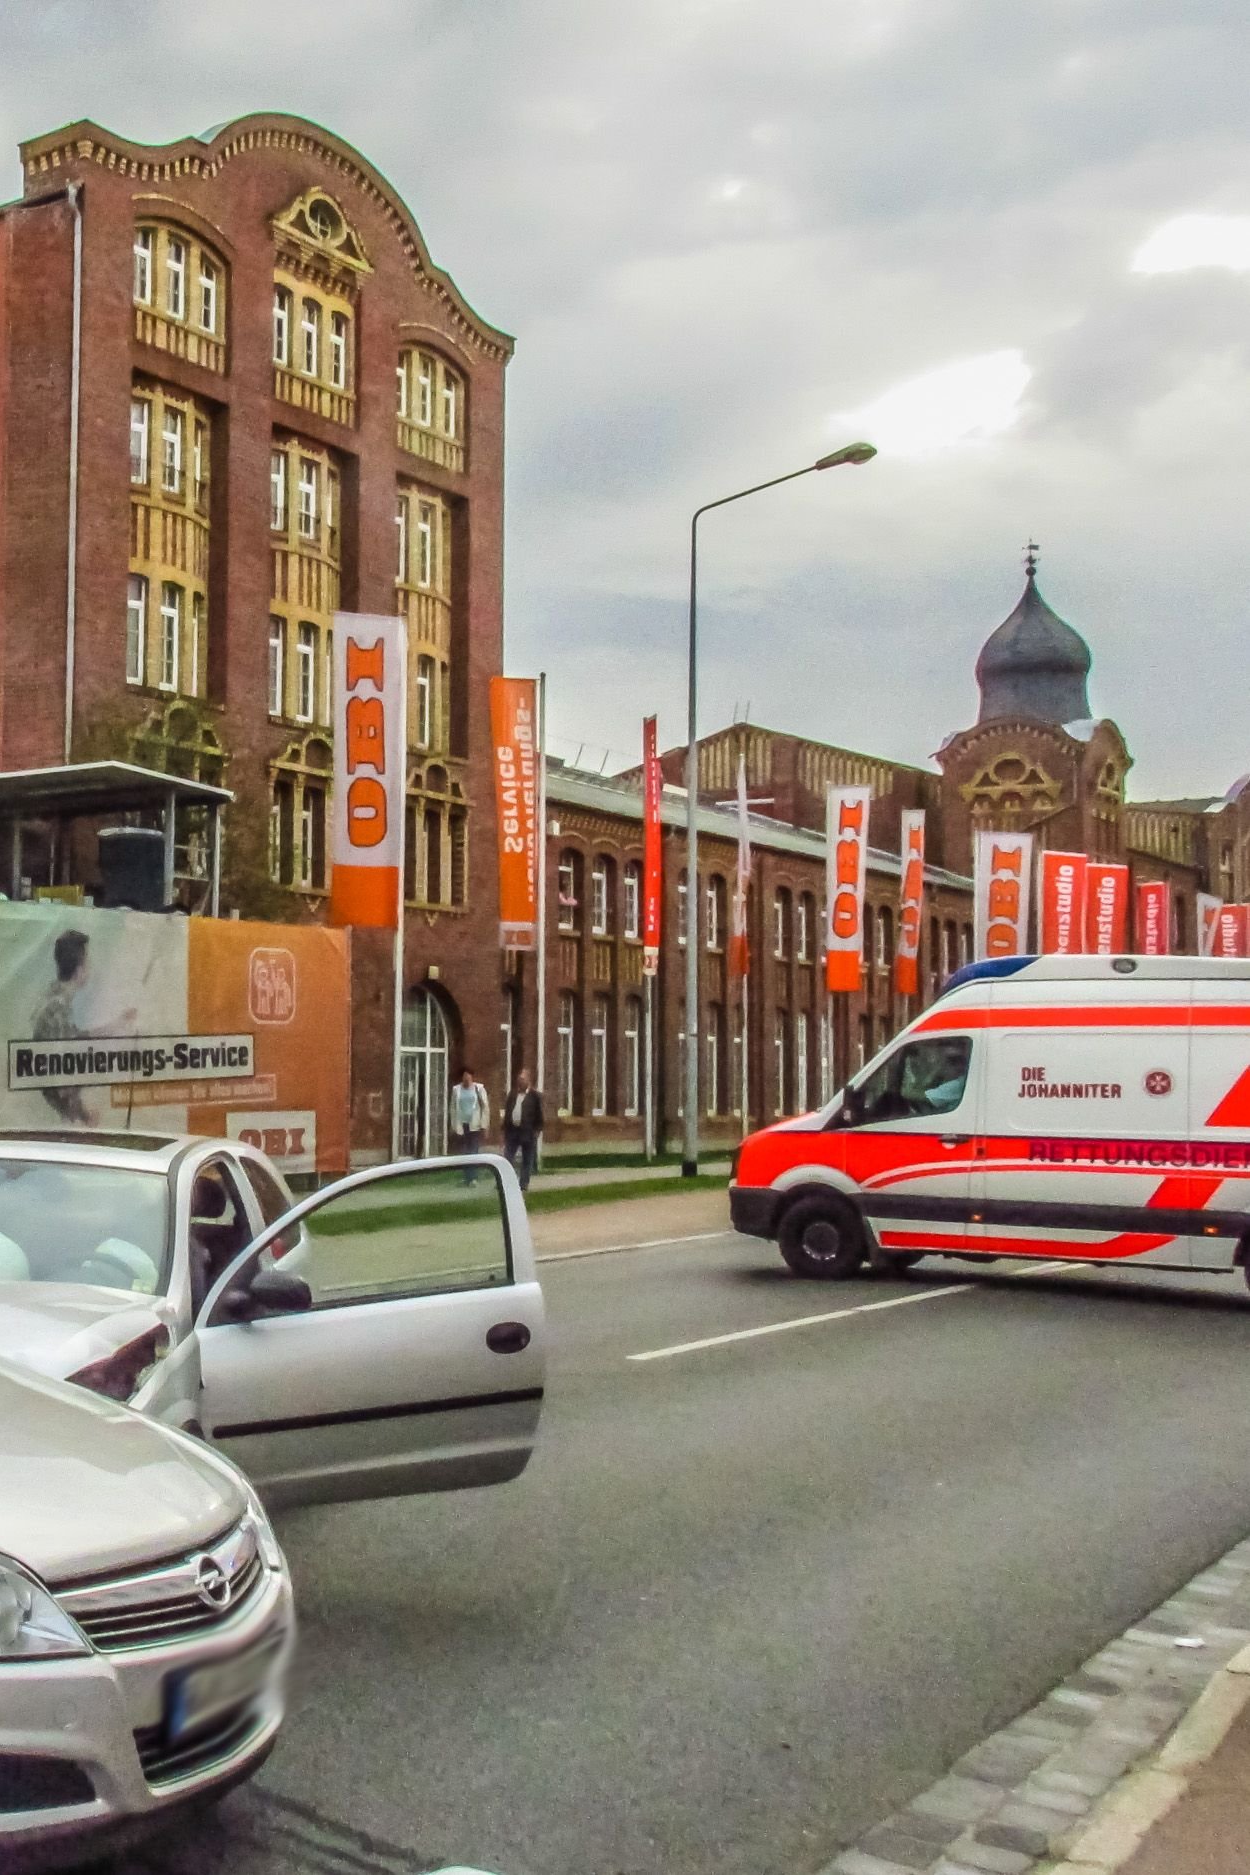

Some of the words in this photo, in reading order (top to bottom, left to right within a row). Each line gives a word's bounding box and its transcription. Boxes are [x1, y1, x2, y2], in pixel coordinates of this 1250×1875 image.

[346, 636, 387, 848] OBI
[833, 800, 862, 939] OBI
[986, 845, 1022, 957] OBI
[16, 1042, 249, 1077] Renovierungs-Service
[1021, 1067, 1046, 1081] DIE
[1018, 1083, 1121, 1098] JOHANNITER
[238, 1128, 306, 1155] OBI
